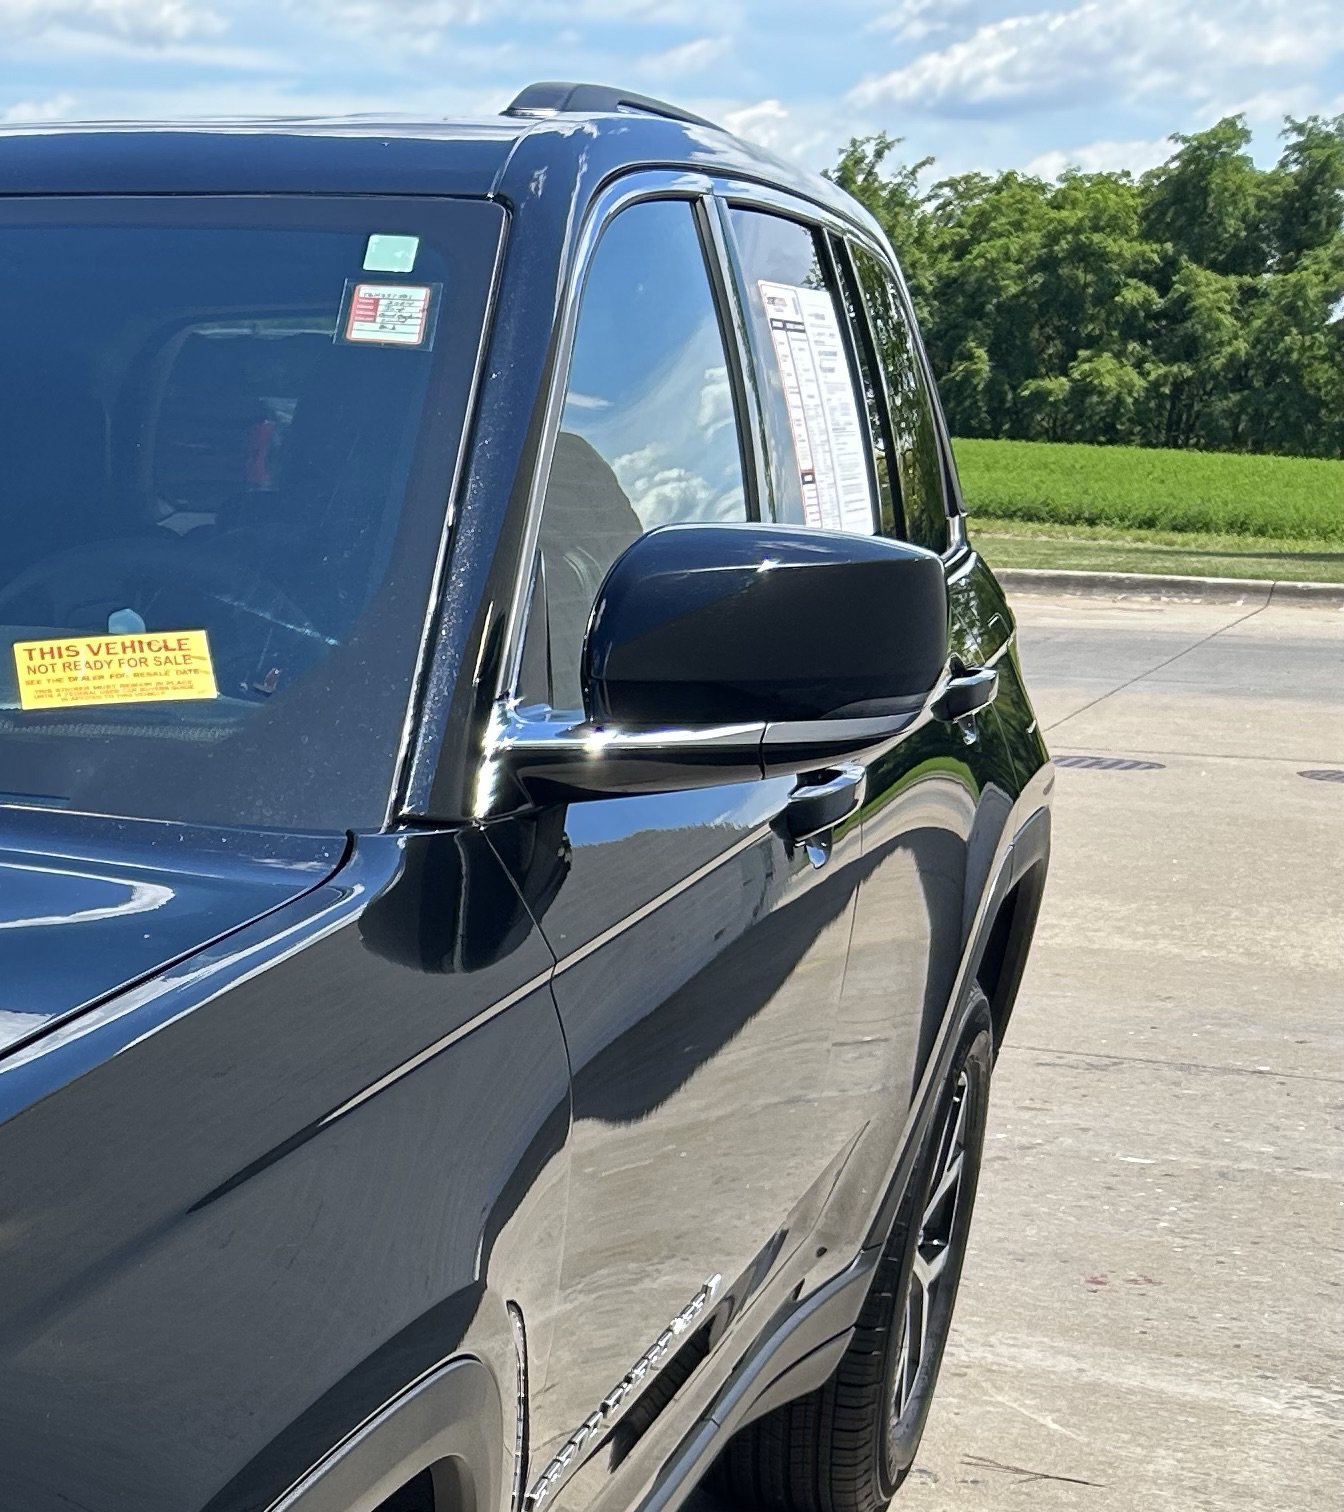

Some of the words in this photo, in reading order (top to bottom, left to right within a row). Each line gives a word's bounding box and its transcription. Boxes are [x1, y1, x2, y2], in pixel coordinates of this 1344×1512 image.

[23, 645, 80, 661] THIS
[86, 638, 192, 656] VEHICLE
[26, 662, 57, 675] NOT
[62, 660, 113, 673] READY
[118, 657, 149, 669] FOR
[153, 654, 193, 667] SALE
